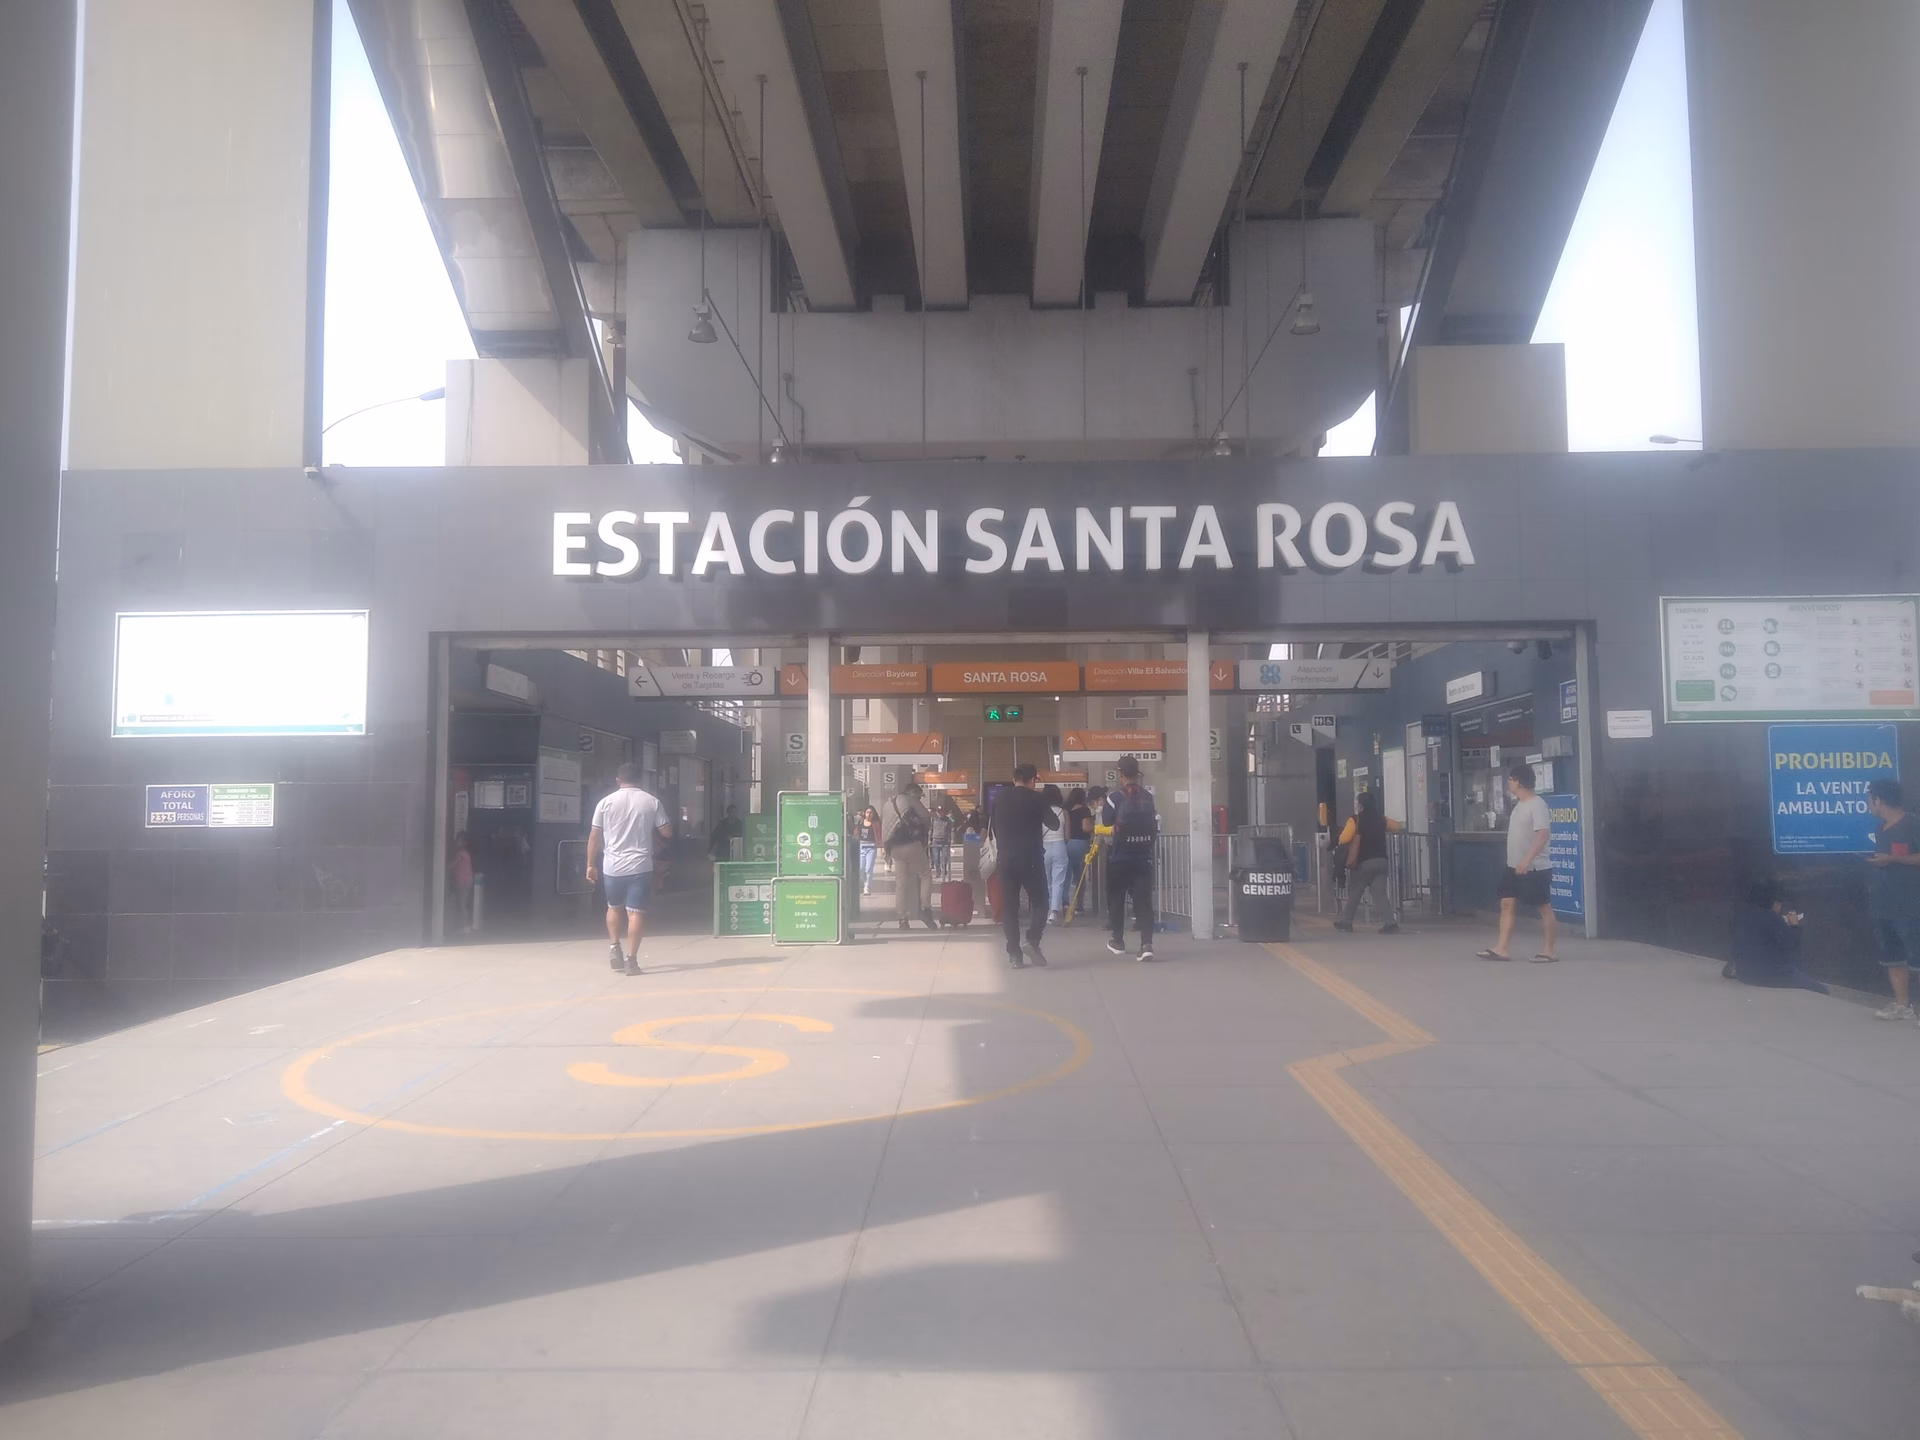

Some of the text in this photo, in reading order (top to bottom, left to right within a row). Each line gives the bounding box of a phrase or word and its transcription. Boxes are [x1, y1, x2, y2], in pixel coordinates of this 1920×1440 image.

[553, 495, 1476, 577] ESTACIÓN SANTA ROSA
[1093, 666, 1189, 676] Dirección Villa El Salvado
[1297, 664, 1332, 673] Atención
[672, 671, 735, 682] Venta y Recarga
[852, 670, 918, 680] Dirección Bayóvar
[964, 671, 1048, 684] SANTA ROSA
[1291, 674, 1338, 684] Preferencial
[682, 681, 725, 691] de Tarjetas
[789, 734, 804, 750] S
[1775, 752, 1893, 769] PROHIBIDA
[885, 773, 894, 783] S
[1106, 771, 1115, 780] S
[1796, 782, 1817, 795] LA
[161, 790, 196, 799] AFORO
[162, 801, 194, 810] TOTAL
[1777, 801, 1869, 815] AMBULATO
[152, 813, 175, 822] 2325
[177, 812, 205, 822] PERSONAS
[1549, 808, 1579, 823] OHIBIDO
[1572, 830, 1579, 841] de
[1566, 846, 1572, 855] en
[1573, 845, 1578, 855] el
[1562, 859, 1568, 869] de
[1568, 859, 1576, 869] las
[566, 1012, 836, 1089] S
